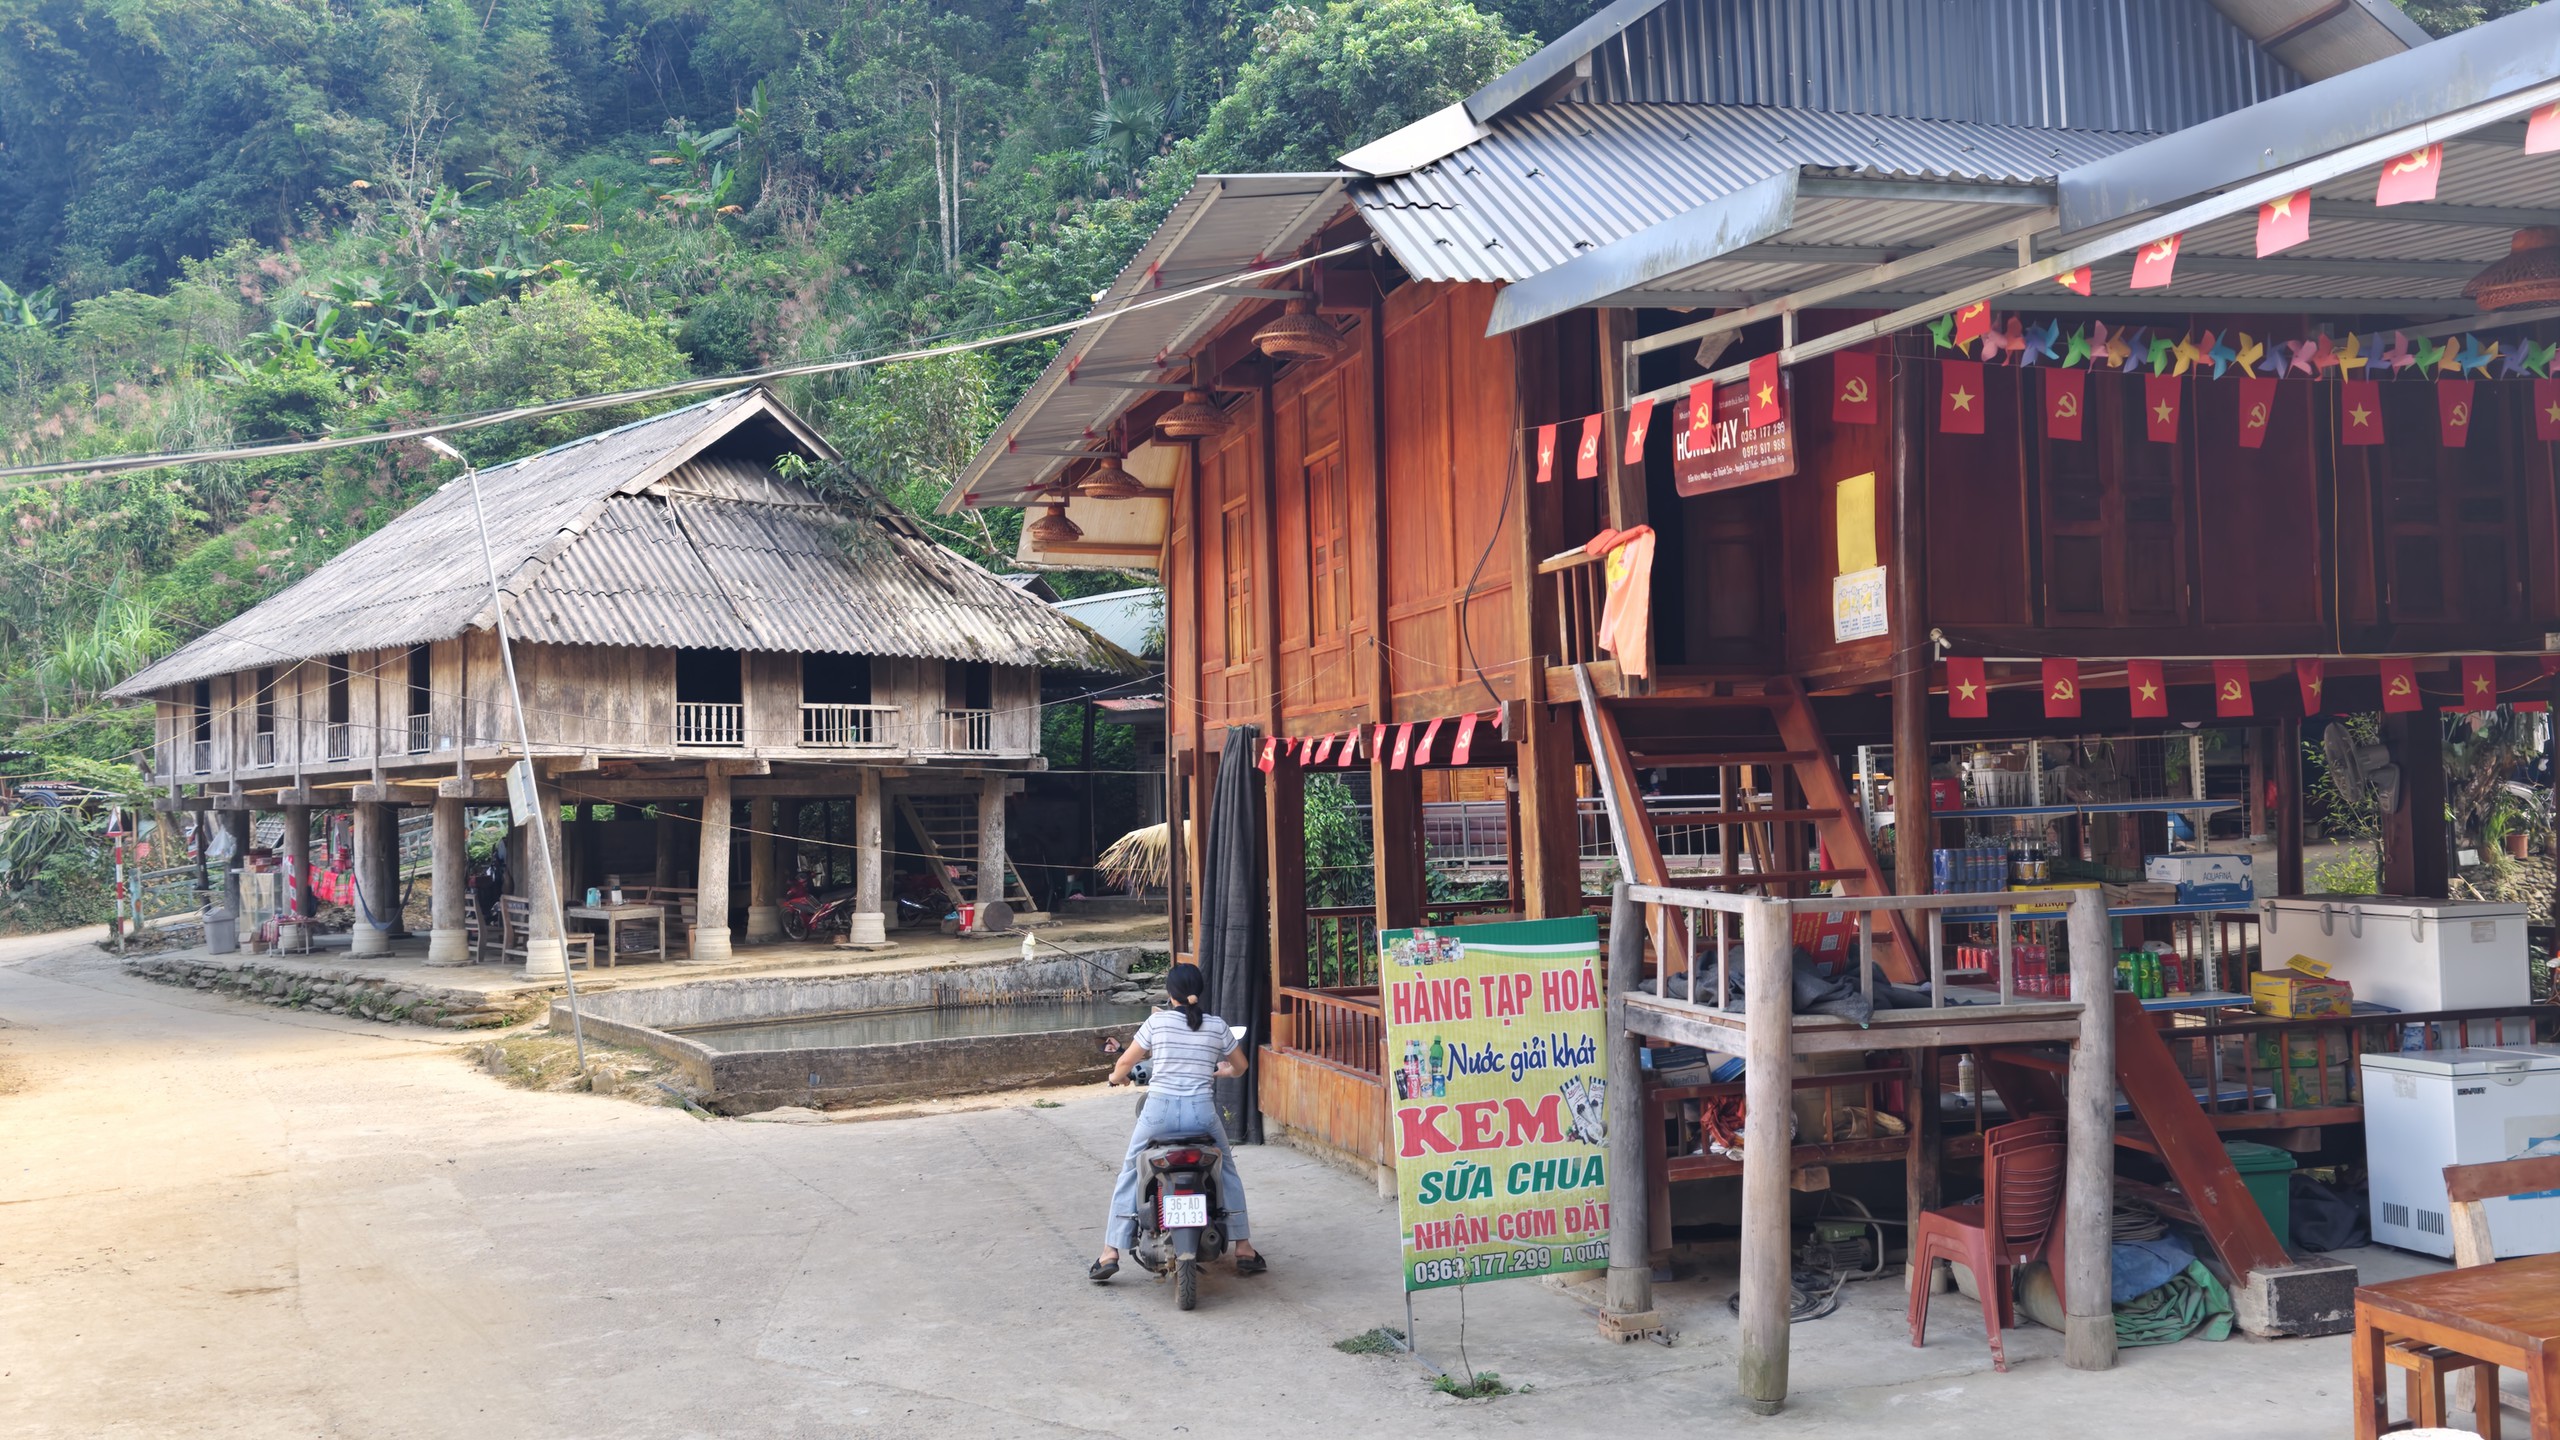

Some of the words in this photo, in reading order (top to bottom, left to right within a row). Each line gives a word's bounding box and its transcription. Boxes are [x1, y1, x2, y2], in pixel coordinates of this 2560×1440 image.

[1676, 418, 1738, 461] HOSTAY
[1741, 429, 1757, 443] 0363
[1760, 425, 1771, 438] 177
[1773, 421, 1785, 435] 299
[1742, 444, 1758, 458] 0972
[2203, 872, 2233, 881] AQUAFINA
[1392, 971, 1472, 1025] HÀNG
[1479, 973, 1533, 1026] TẠP
[1541, 959, 1600, 1013] HOÁ
[1446, 1042, 1505, 1081] Nước
[1510, 1036, 1547, 1082] giải
[1551, 1032, 1596, 1068] khát
[1397, 1094, 1565, 1158] KEM
[1418, 1159, 1493, 1205] SỮA
[1507, 1154, 1605, 1195] CHUA
[1167, 1211, 1204, 1225] 731.33
[1171, 1197, 1200, 1211] 36-AD
[1414, 1213, 1490, 1252] NHẬN
[1497, 1208, 1557, 1241] CƠM
[1564, 1199, 1610, 1237] ĐẶT
[1562, 1247, 1574, 1264] A
